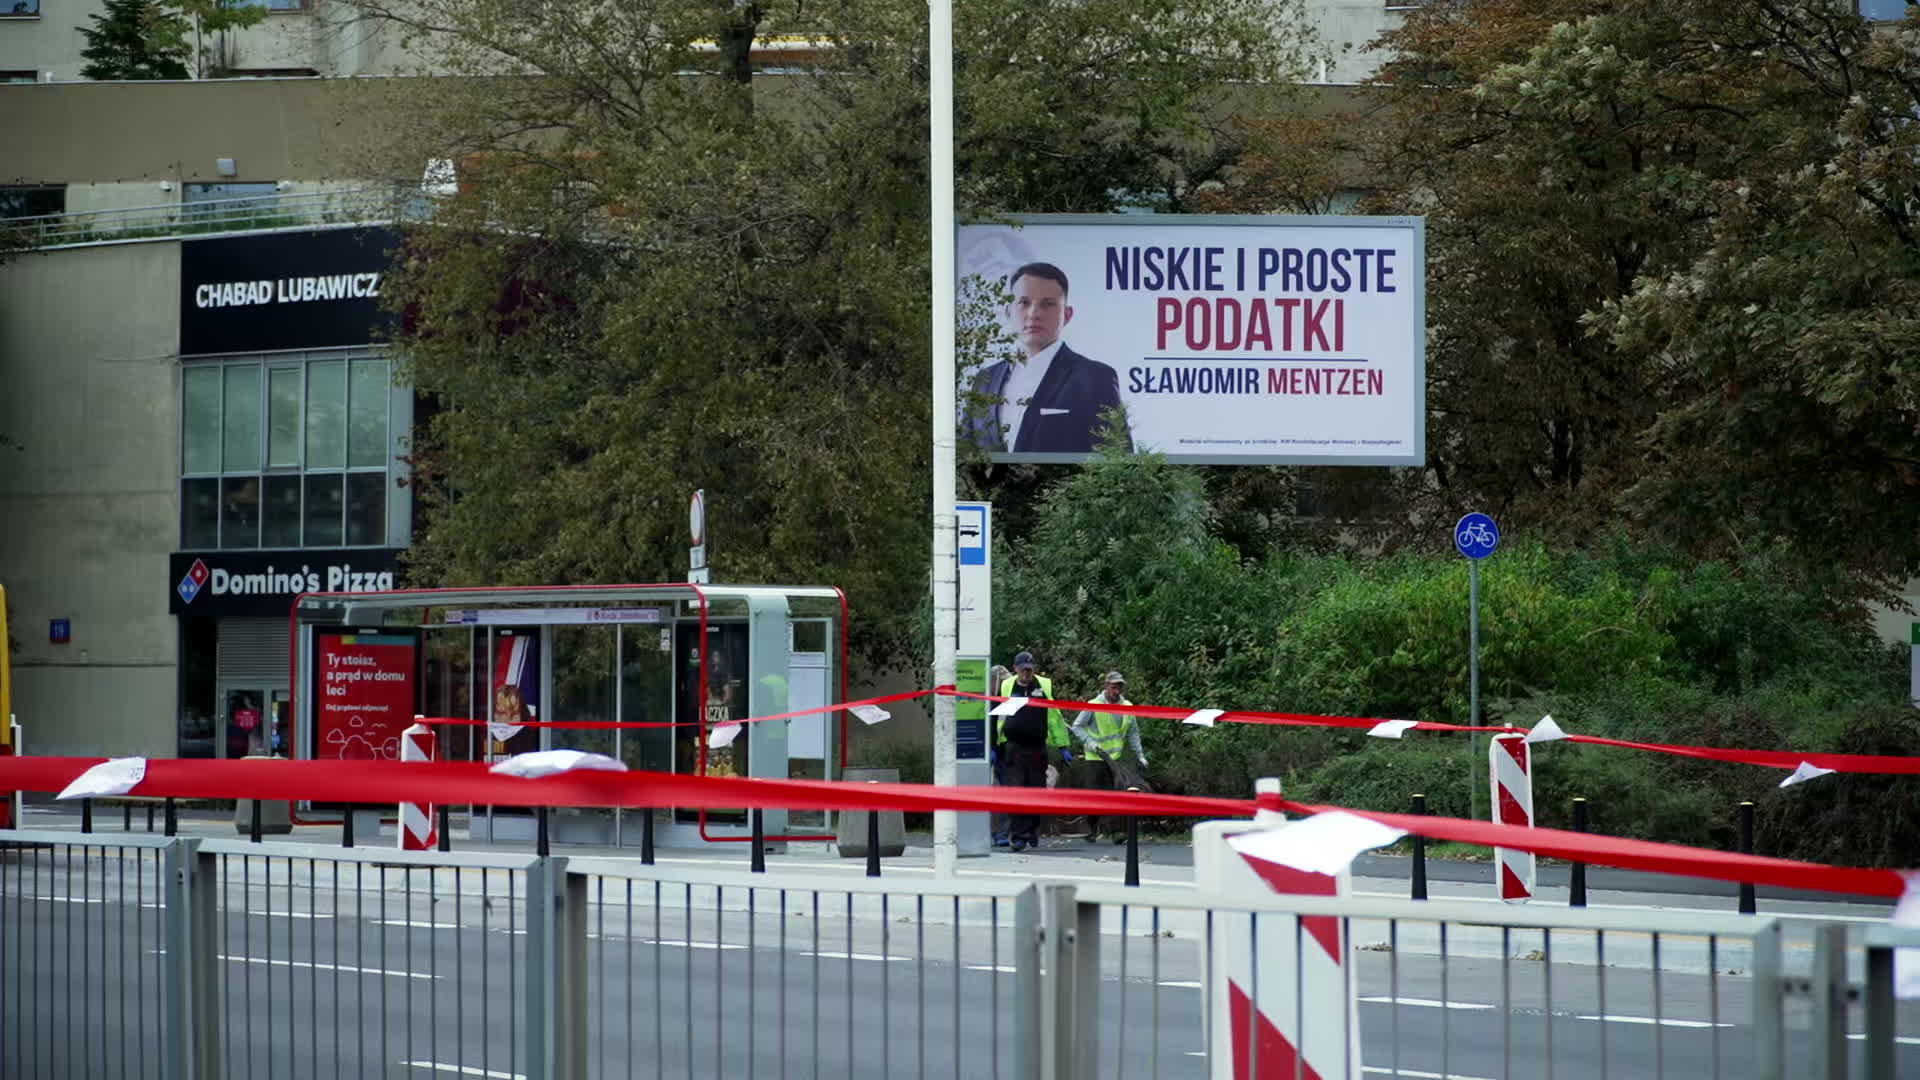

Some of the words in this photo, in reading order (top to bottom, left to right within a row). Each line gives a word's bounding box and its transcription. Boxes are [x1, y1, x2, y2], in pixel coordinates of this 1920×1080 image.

[1105, 247, 1225, 291] NISKIE
[1237, 247, 1245, 291] I
[1258, 248, 1396, 293] PROSTE
[196, 281, 273, 308] CHABAD
[277, 272, 380, 303] LUBAWICZ
[1156, 297, 1344, 352] PODATKI
[1128, 366, 1260, 394] SŁAWOMIR
[1267, 367, 1383, 396] MENTZEN
[210, 565, 321, 595] Domino's
[327, 563, 393, 593] Pizza
[327, 653, 340, 668] Ty
[326, 671, 334, 681] a
[335, 669, 361, 683] prąd
[362, 671, 373, 681] w
[374, 669, 405, 681] domu
[326, 684, 346, 696] leci
[699, 706, 729, 721] CZKA
